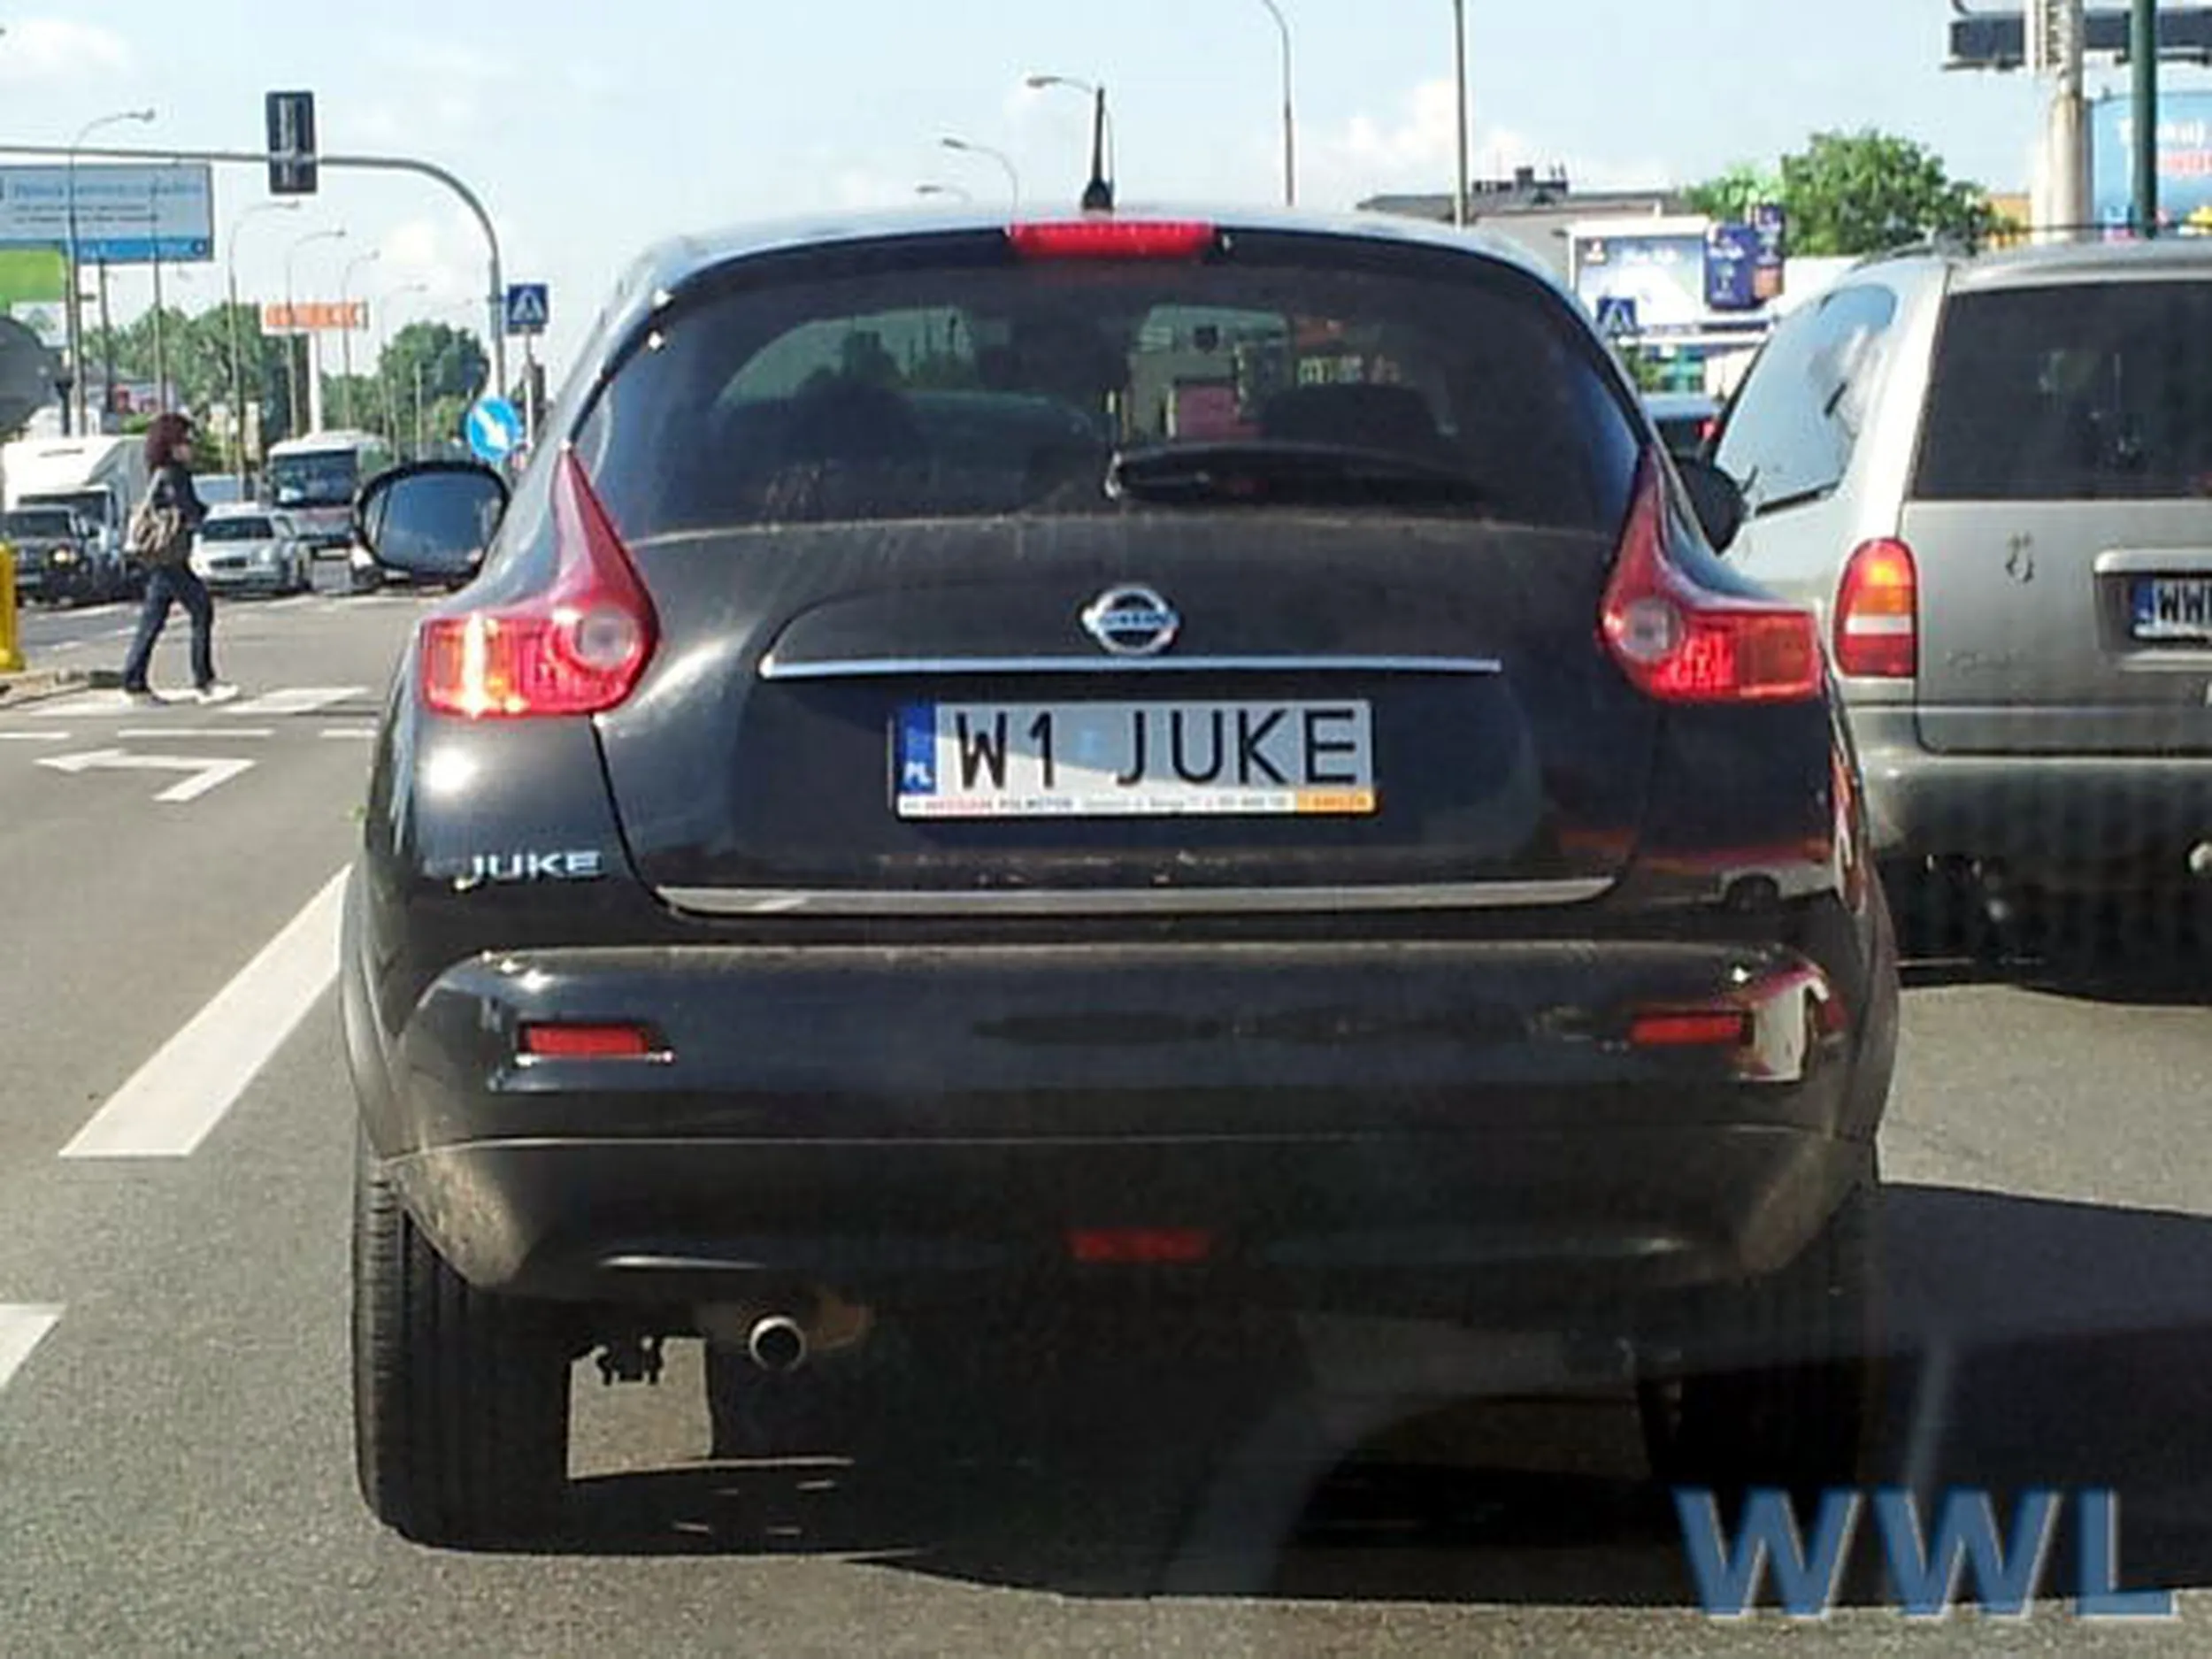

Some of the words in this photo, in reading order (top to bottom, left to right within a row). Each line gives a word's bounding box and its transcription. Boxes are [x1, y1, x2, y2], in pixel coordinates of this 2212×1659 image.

[2158, 584, 2212, 623] WW
[956, 710, 1054, 789] W1
[1117, 708, 1357, 787] JUKE
[455, 851, 601, 889] JUKE
